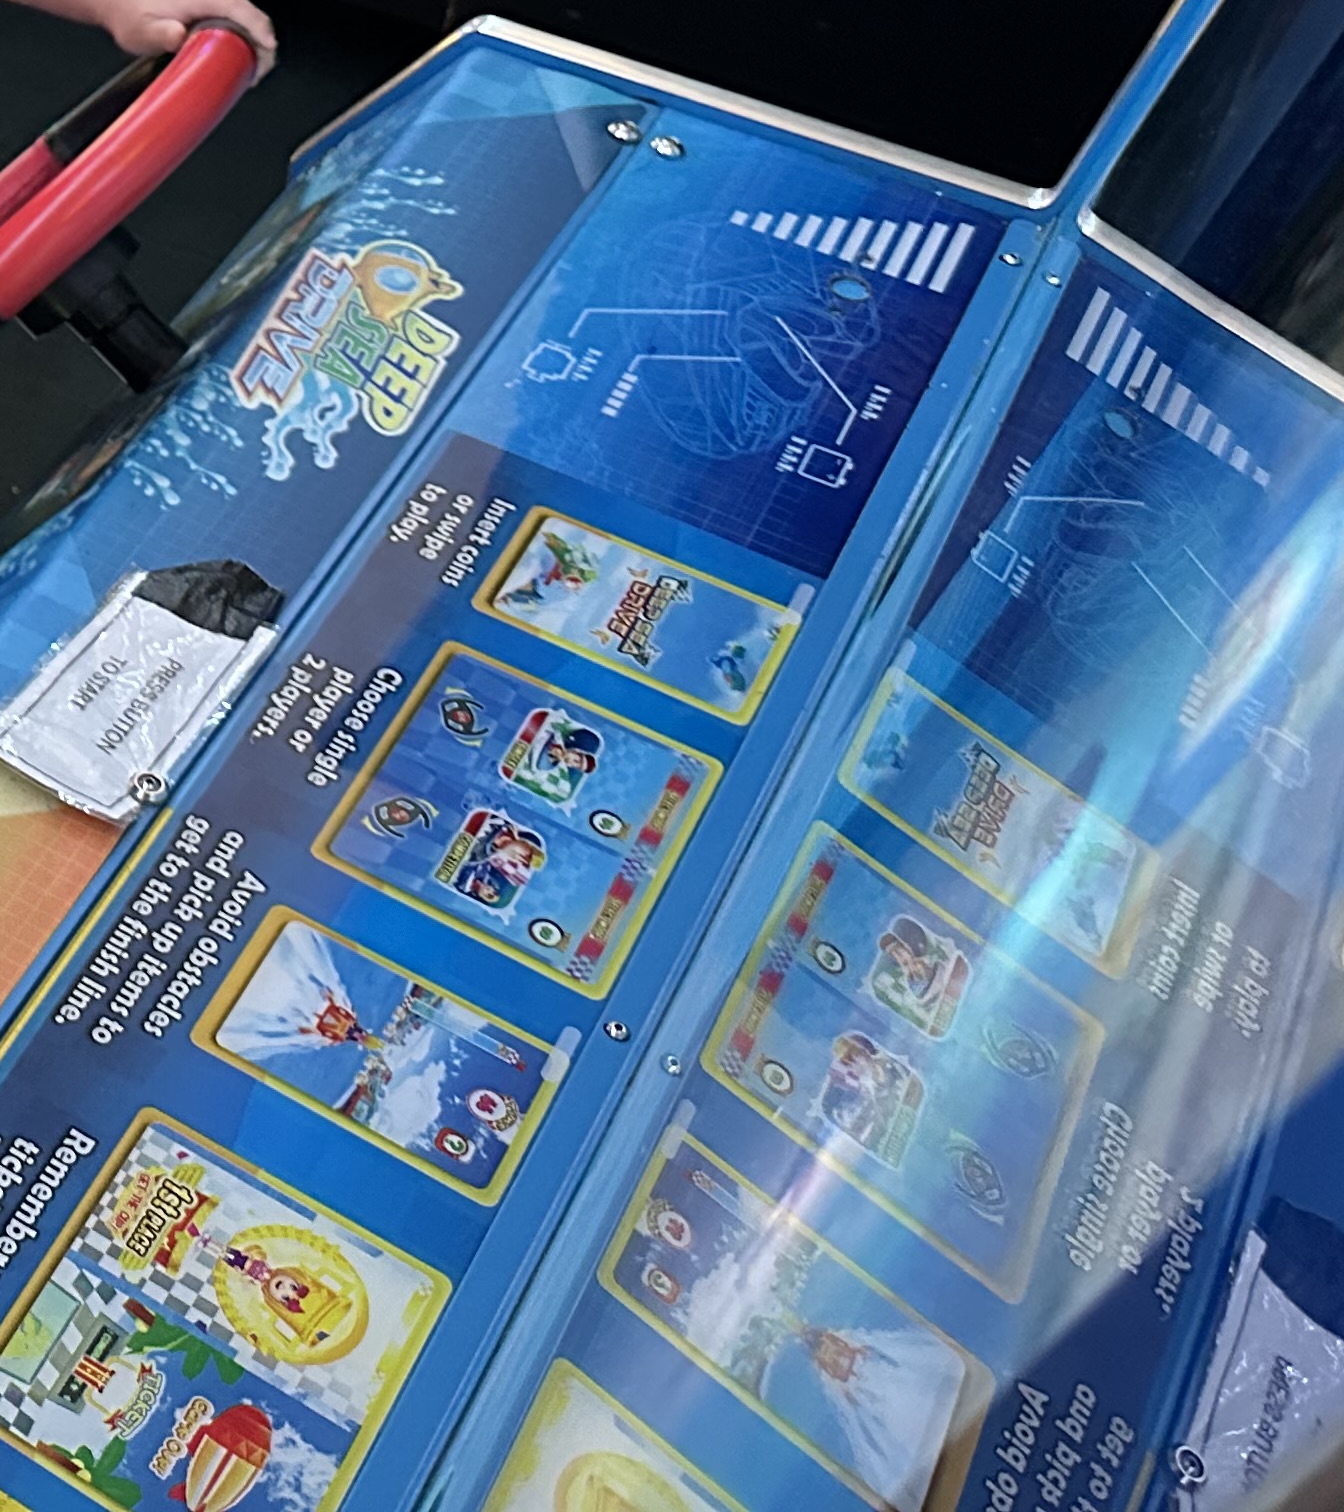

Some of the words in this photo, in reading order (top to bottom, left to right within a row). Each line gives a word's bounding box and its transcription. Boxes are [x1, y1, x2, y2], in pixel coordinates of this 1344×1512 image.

[231, 251, 354, 406] DRIVE
[315, 301, 387, 388] SEA
[368, 312, 459, 431] DEEP
[418, 481, 446, 505] to
[450, 492, 473, 514] or
[385, 497, 432, 548] play.
[416, 510, 462, 562] swipe
[467, 496, 516, 548] Insert
[438, 541, 482, 589] coins
[606, 579, 652, 639] DRIVE
[99, 652, 127, 677] TO
[138, 656, 183, 702] PRESS
[301, 652, 325, 672] 2
[69, 670, 110, 711] START
[249, 664, 313, 742] players.
[301, 665, 358, 733] player
[342, 663, 404, 734] Choose
[95, 696, 150, 756] BUTTON
[286, 726, 313, 753] or
[304, 728, 360, 791] single
[170, 810, 210, 855] get
[203, 828, 246, 876] and
[154, 849, 187, 880] to
[129, 876, 172, 919] the
[170, 869, 216, 924] pick
[206, 870, 267, 940] Avoid
[88, 913, 146, 980] finish
[145, 919, 181, 954] up
[52, 974, 104, 1031] line.
[106, 952, 163, 1018] items
[139, 934, 222, 1039] obstacles
[88, 1015, 119, 1044] to
[126, 1192, 142, 1210] THE
[135, 1172, 152, 1191] GET
[149, 1177, 196, 1221] 1st
[124, 1208, 167, 1257] PLACE
[116, 1374, 162, 1437] TICKET
